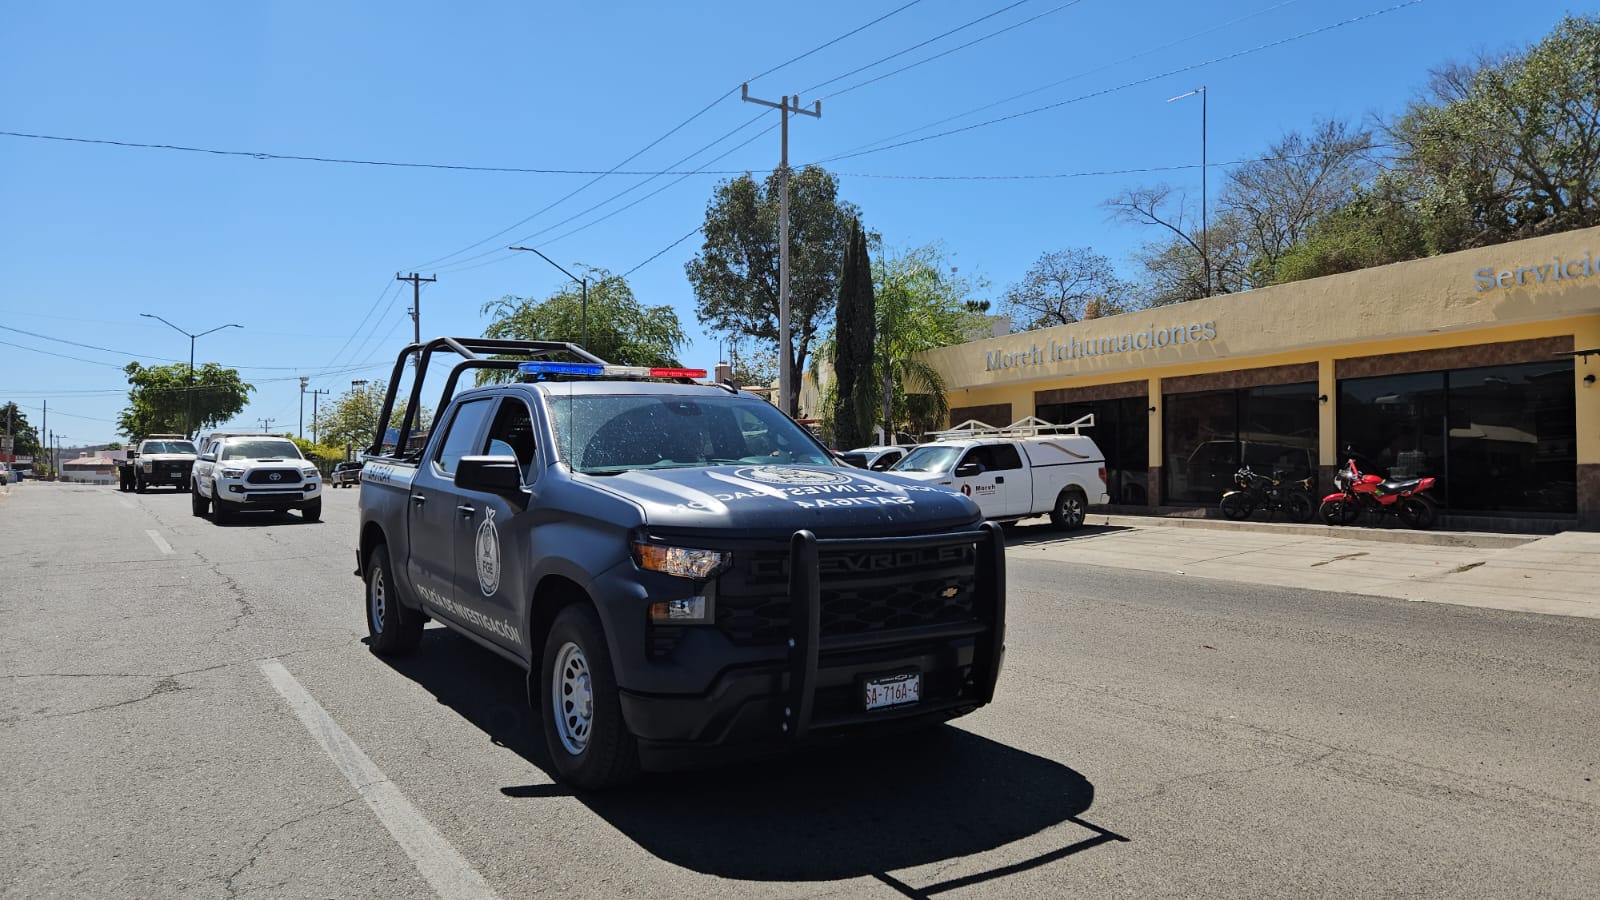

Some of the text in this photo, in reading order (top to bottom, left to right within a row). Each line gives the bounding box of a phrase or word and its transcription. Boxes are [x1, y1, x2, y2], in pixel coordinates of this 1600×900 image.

[984, 319, 1217, 371] Moreh Inhumaciones
[482, 559, 493, 575] FGE
[751, 546, 973, 577] CEVROLE
[865, 681, 920, 705] SA-716A-4
